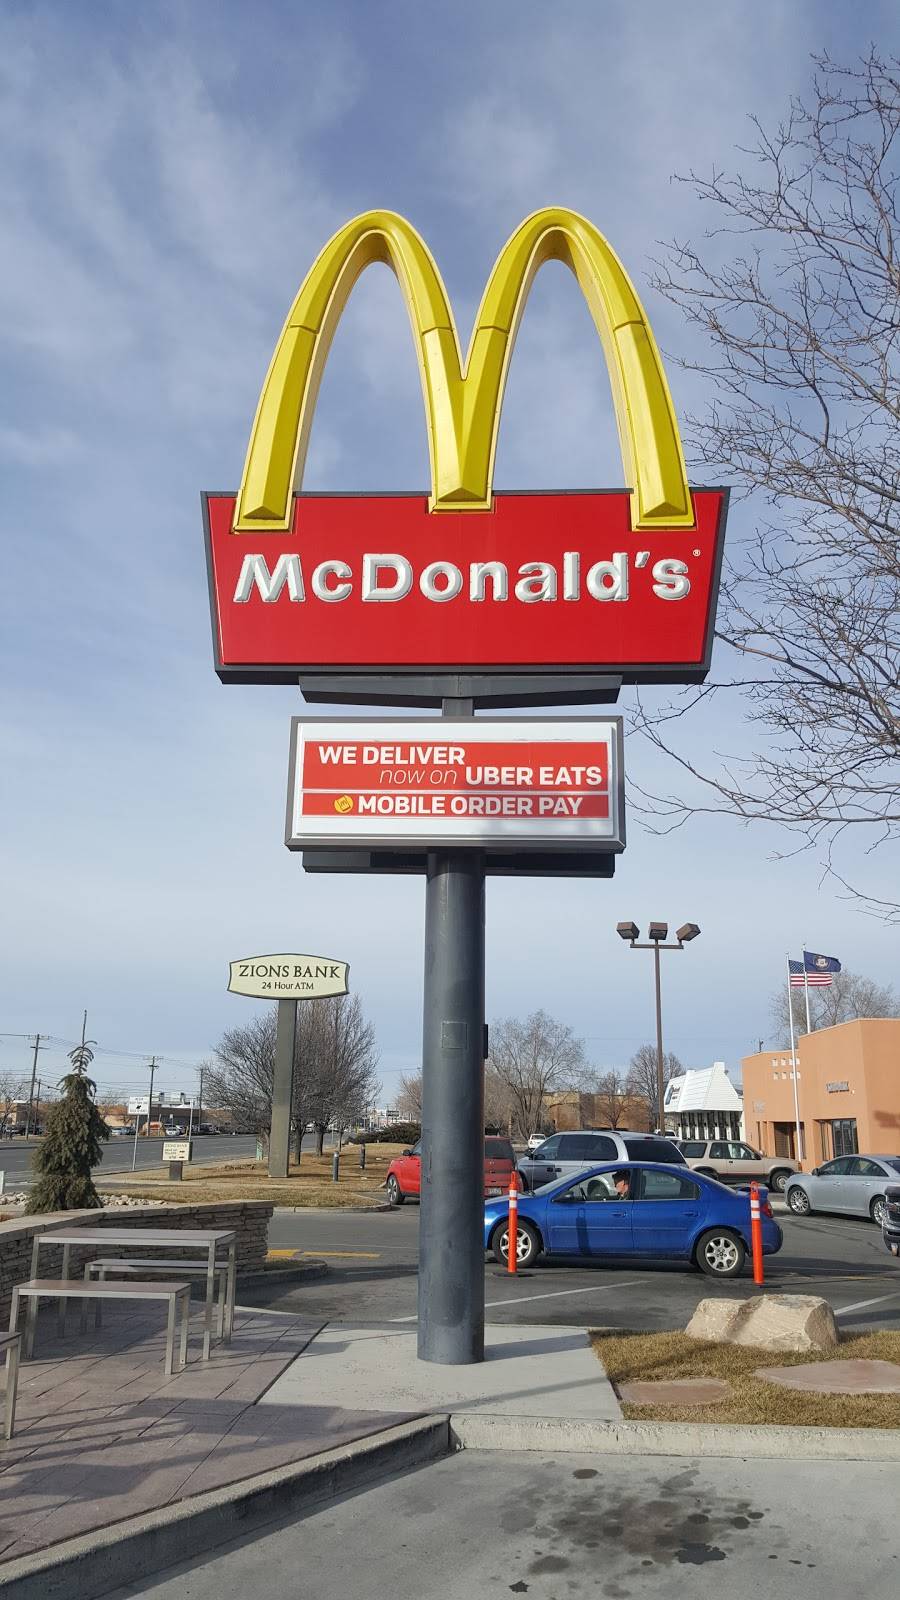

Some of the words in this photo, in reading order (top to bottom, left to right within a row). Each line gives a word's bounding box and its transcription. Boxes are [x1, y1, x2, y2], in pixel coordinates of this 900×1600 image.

[232, 551, 692, 603] McDonald's
[318, 745, 357, 765] WE
[362, 746, 466, 766] DELIVER
[378, 769, 426, 785] now
[429, 769, 458, 785] on
[465, 766, 533, 786] UBER
[539, 766, 602, 786] EATS
[357, 795, 446, 815] MOBILE
[449, 796, 533, 816] ORDER
[539, 796, 583, 816] PAY
[238, 964, 290, 978] ZIONS
[293, 965, 339, 979] BANK
[261, 981, 272, 990] 24
[274, 981, 294, 990] Hour
[294, 981, 314, 990] ATM
